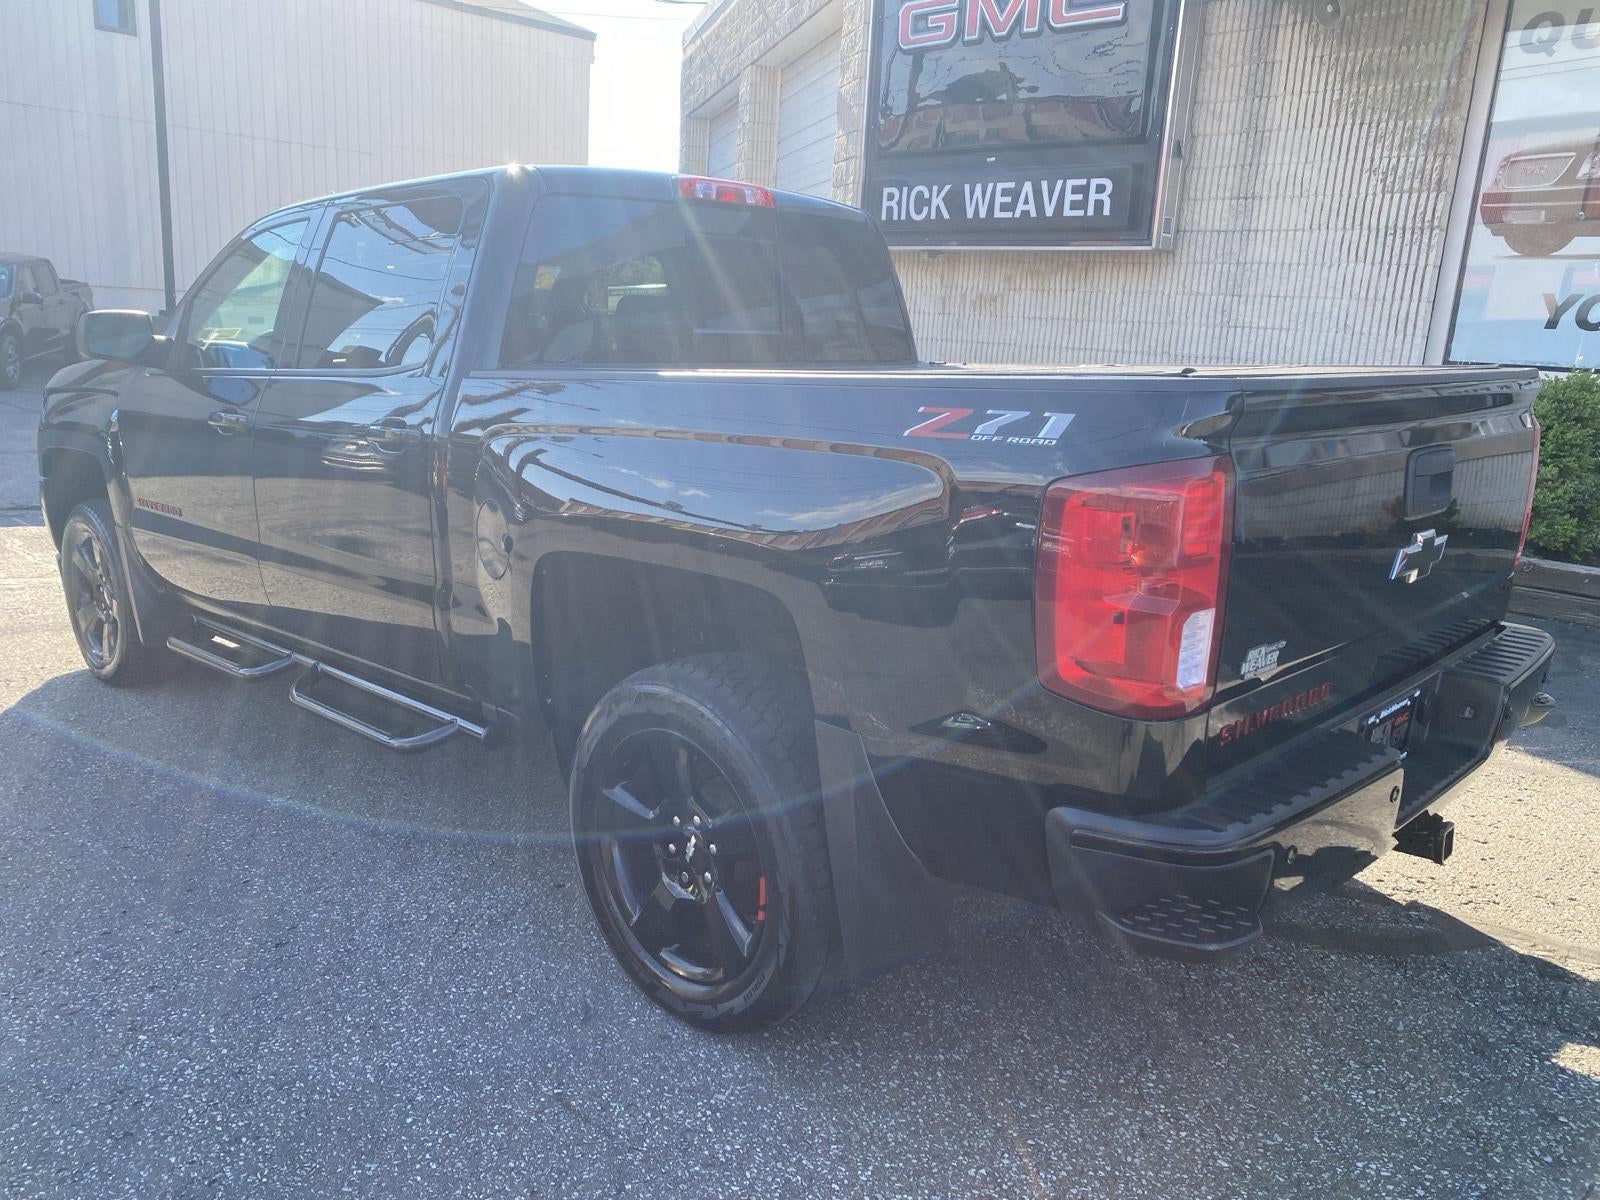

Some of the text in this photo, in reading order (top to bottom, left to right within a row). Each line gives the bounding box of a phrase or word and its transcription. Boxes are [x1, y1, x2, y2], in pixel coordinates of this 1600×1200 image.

[899, 0, 1127, 50] GMC
[881, 177, 1113, 221] RICK WEAVER
[903, 406, 1076, 440] Z71
[970, 434, 1058, 446] OFF ROAD
